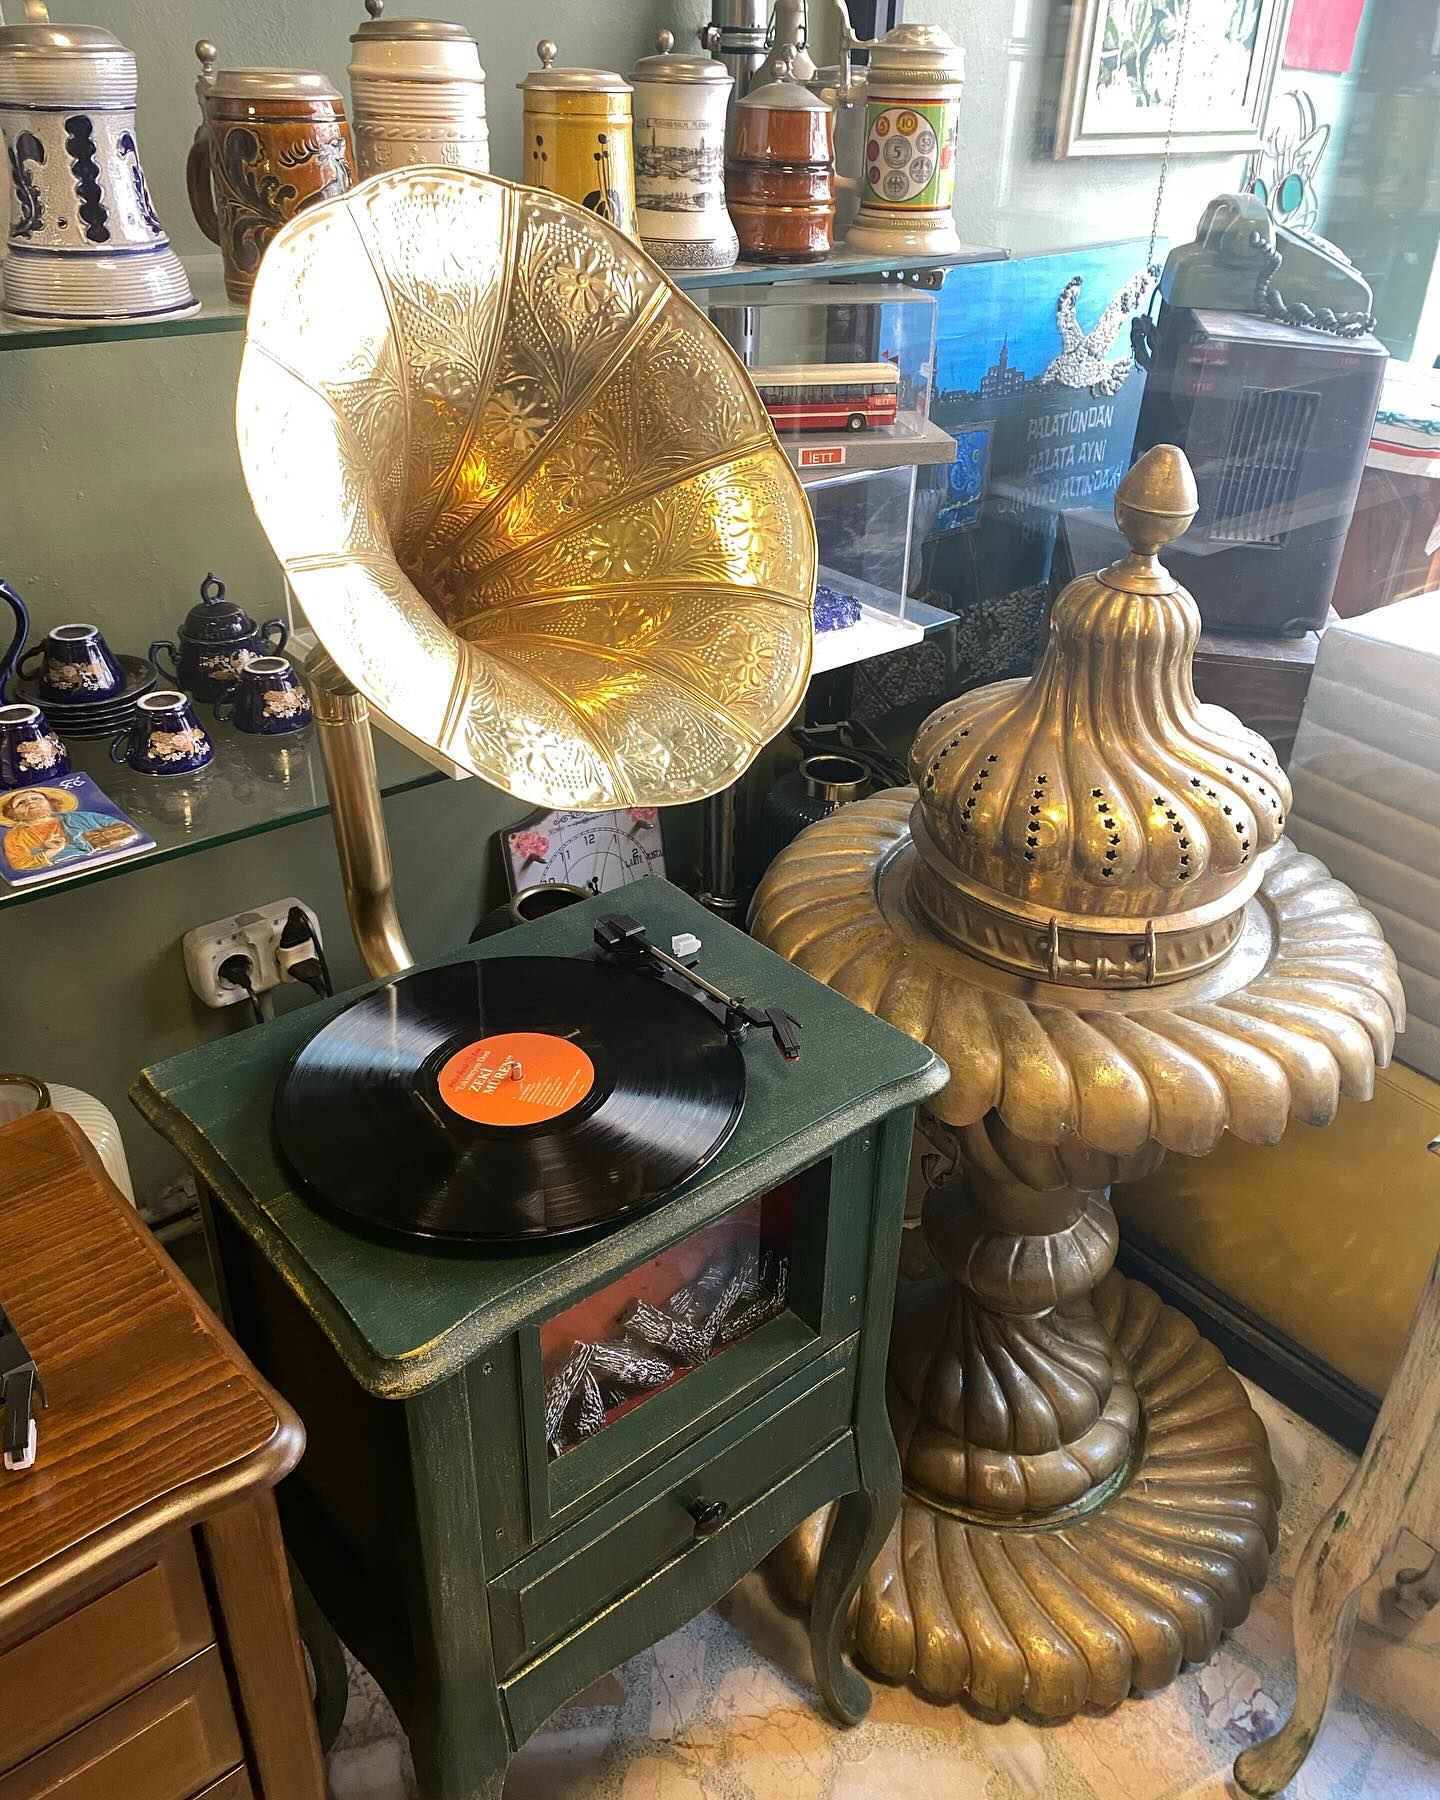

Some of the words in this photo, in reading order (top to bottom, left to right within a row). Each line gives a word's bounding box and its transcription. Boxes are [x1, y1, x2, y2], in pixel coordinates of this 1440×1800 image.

[902, 118, 913, 128] 10
[893, 146, 901, 158] 5
[809, 451, 835, 464] İETT
[584, 833, 597, 847] 12
[613, 834, 618, 845] 1
[560, 849, 571, 862] 11
[632, 848, 639, 858] 2
[469, 1067, 493, 1093] ZEKİ
